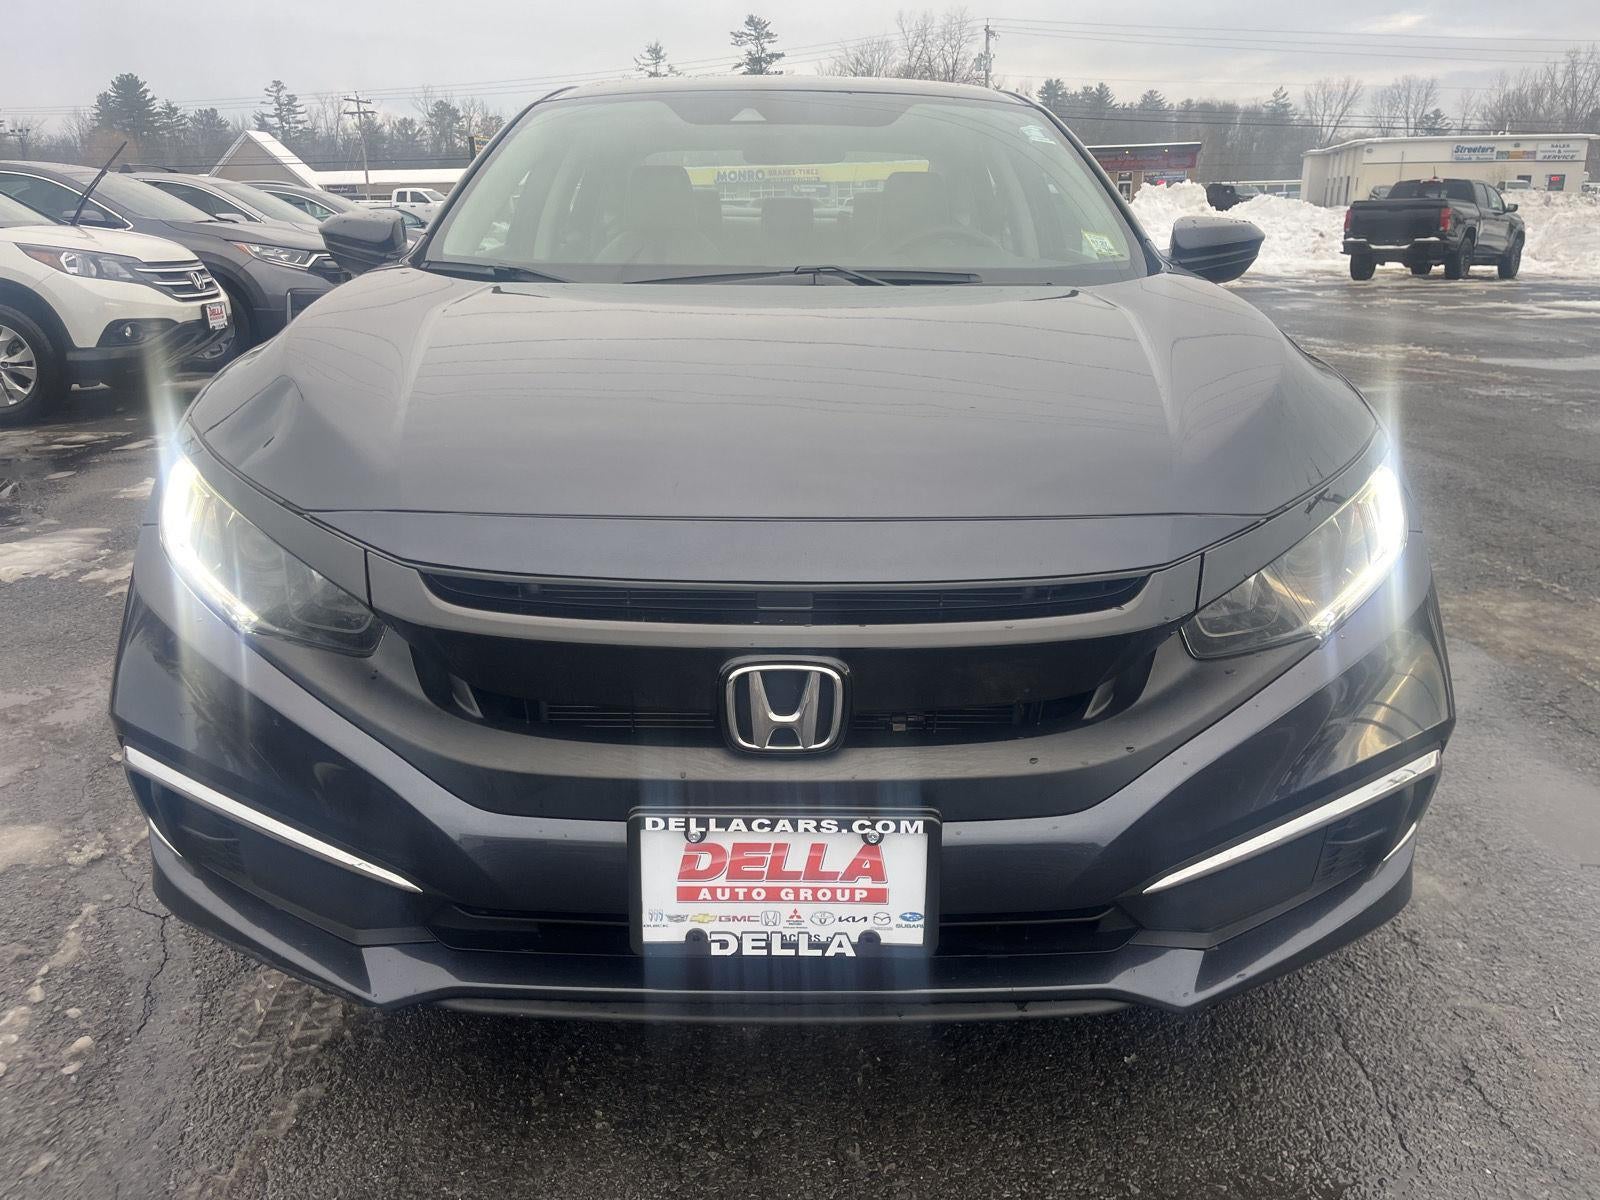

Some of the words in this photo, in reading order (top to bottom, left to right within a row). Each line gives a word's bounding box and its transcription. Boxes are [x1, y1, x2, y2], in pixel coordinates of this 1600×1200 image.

[717, 169, 765, 183] MONRO
[645, 816, 924, 834] DELLACARS.COM
[677, 842, 888, 884] DELLA
[698, 887, 767, 901] AUTO
[780, 888, 868, 902] GROUP
[718, 915, 760, 923] GMC
[710, 932, 856, 957] DELLA
